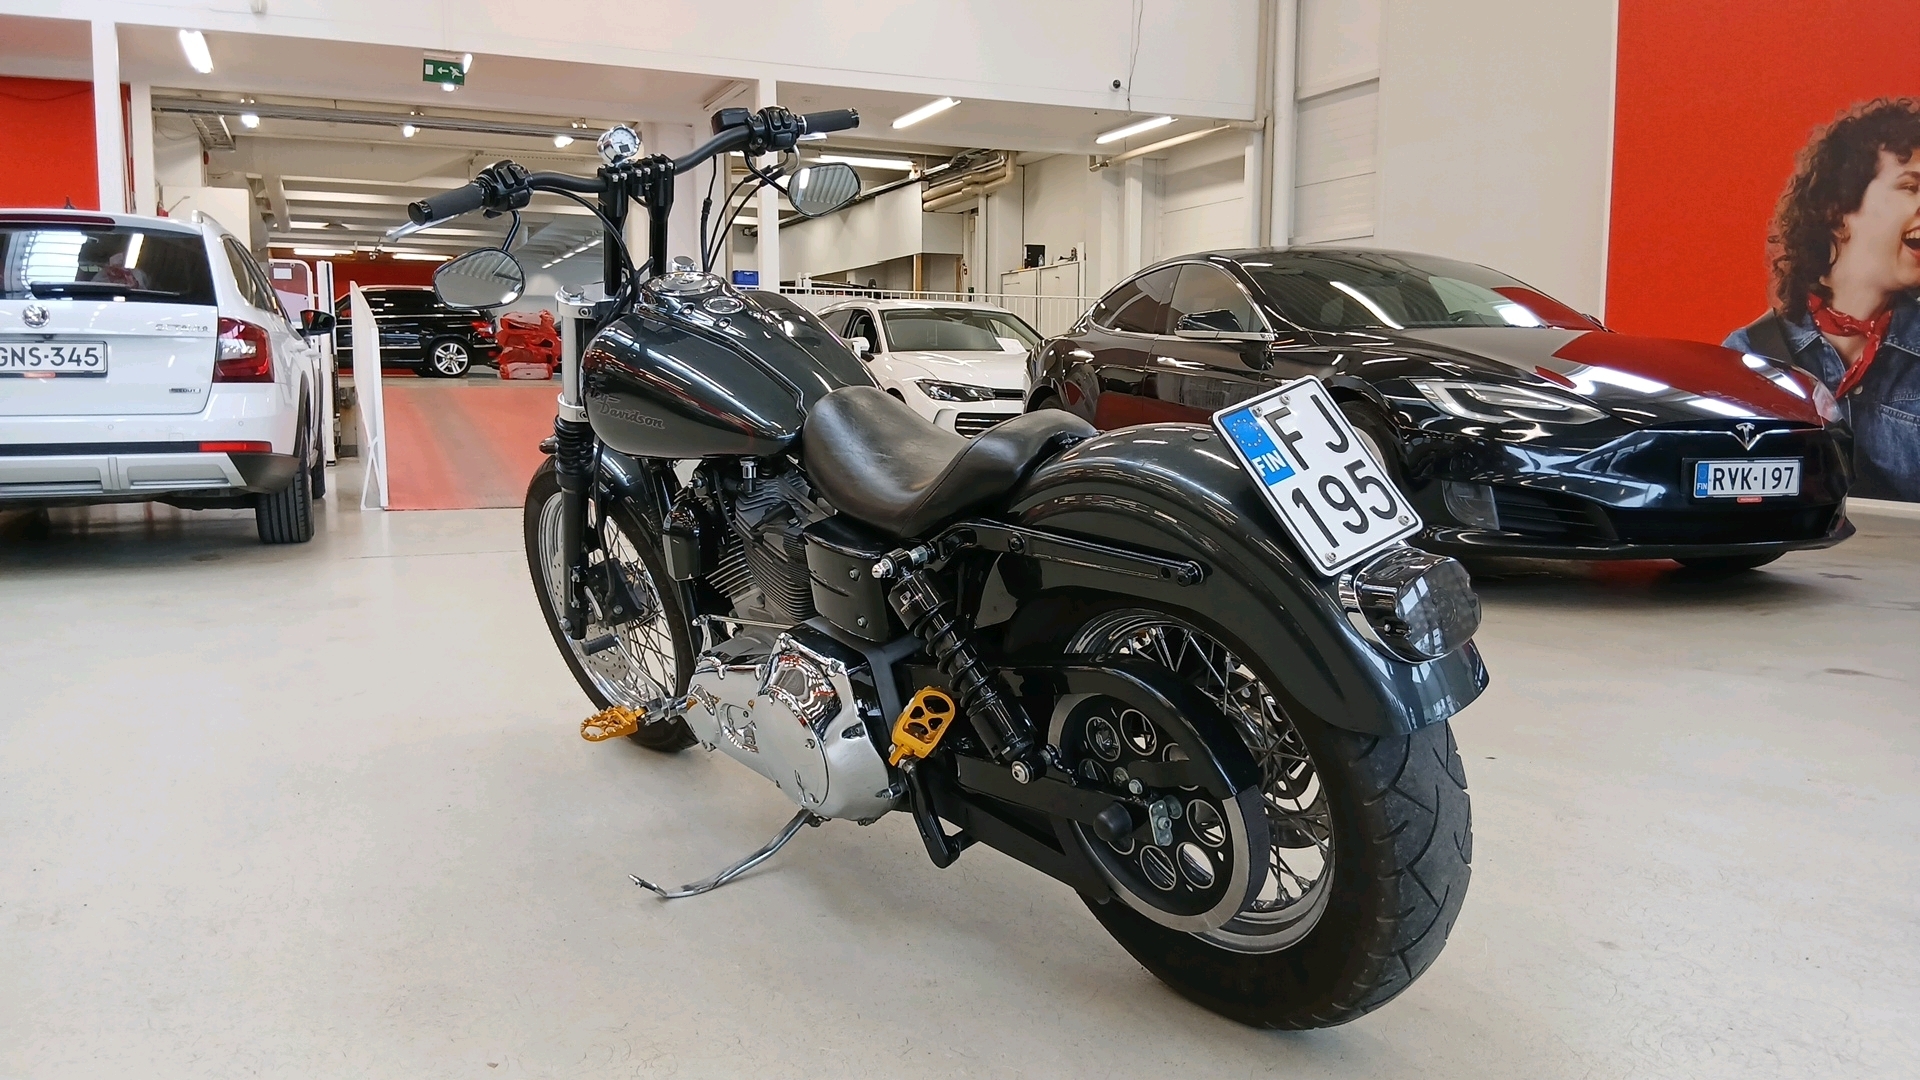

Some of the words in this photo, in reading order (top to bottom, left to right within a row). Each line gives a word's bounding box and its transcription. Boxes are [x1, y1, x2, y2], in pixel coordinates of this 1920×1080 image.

[600, 401, 666, 430] Davidson
[1264, 394, 1350, 471] FJ
[1251, 450, 1287, 478] FIN
[1696, 482, 1708, 491] FIN
[1291, 459, 1398, 549] 195
